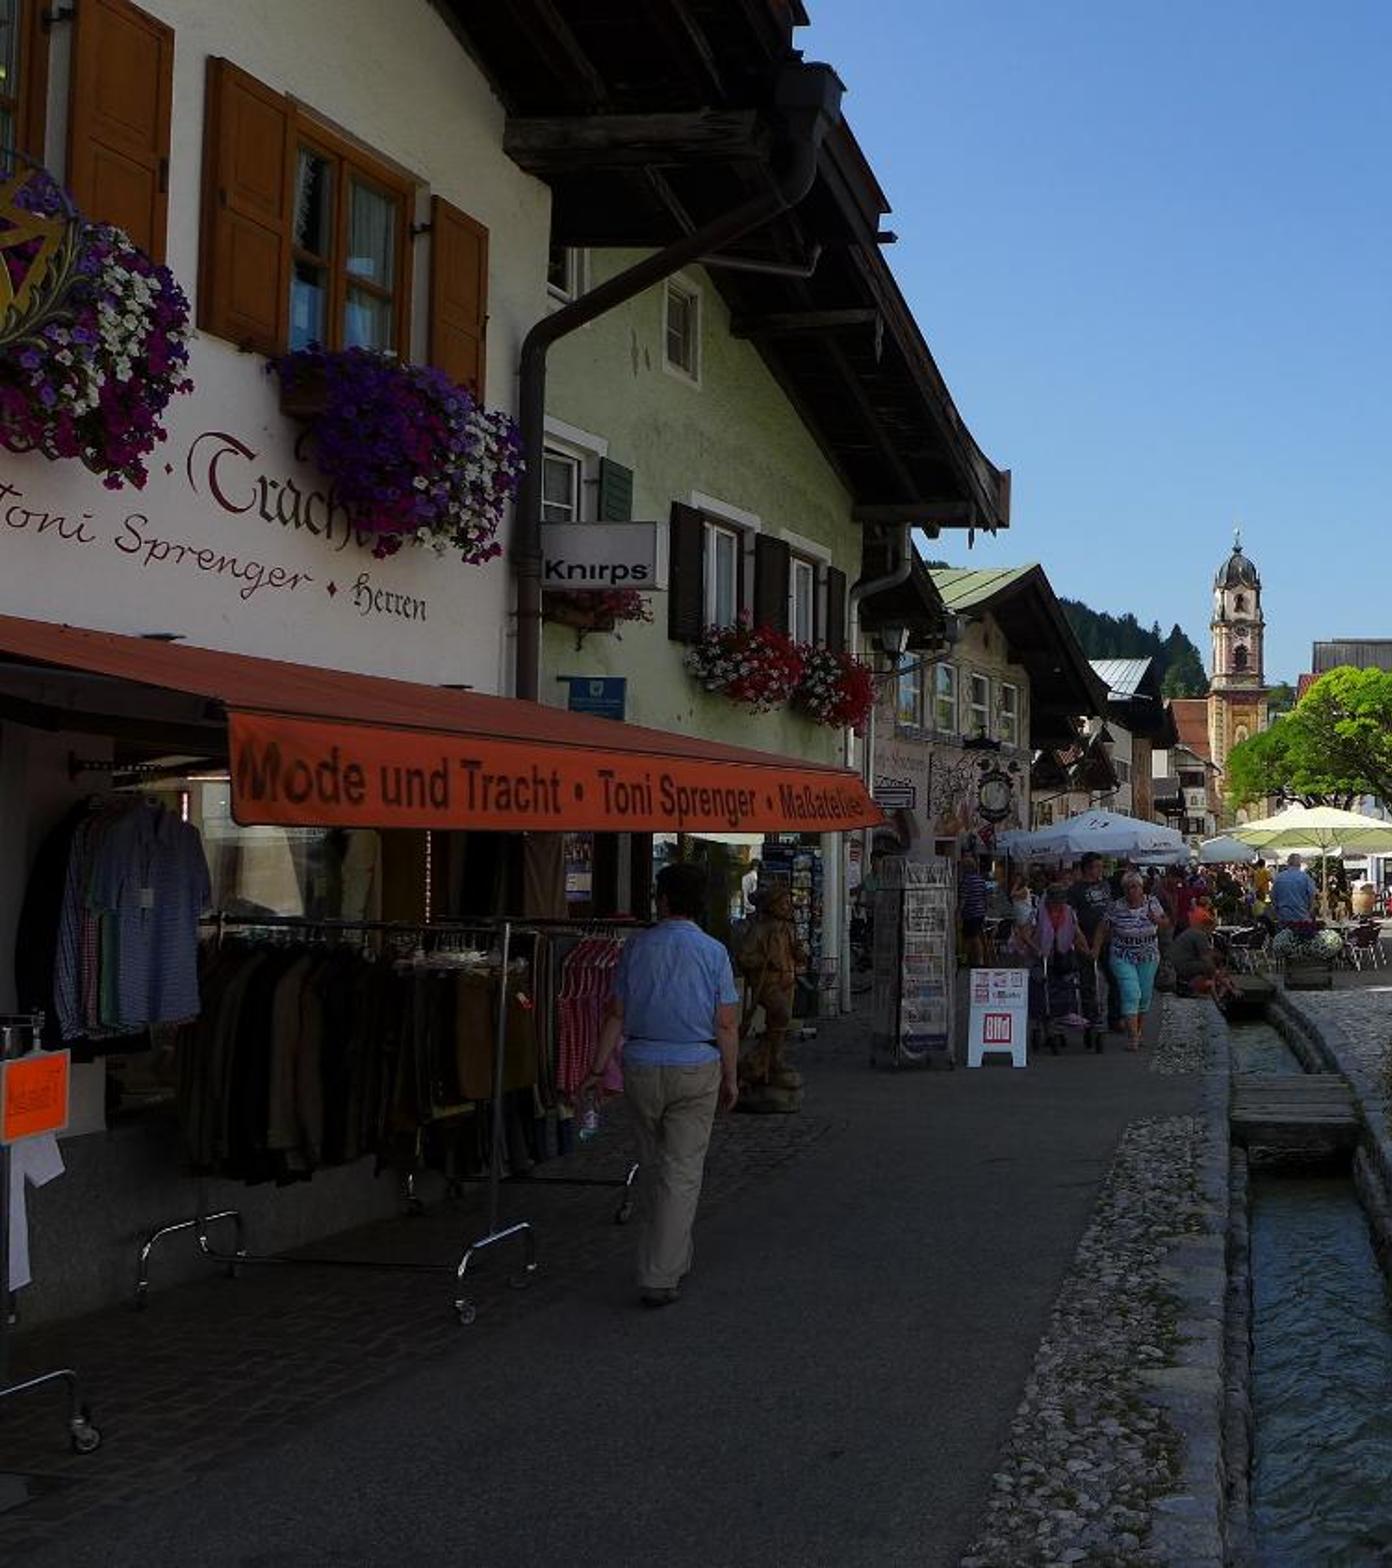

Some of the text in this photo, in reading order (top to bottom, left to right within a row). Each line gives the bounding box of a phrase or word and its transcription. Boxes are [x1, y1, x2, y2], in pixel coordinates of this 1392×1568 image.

[114, 513, 313, 600] Sprenger
[351, 572, 426, 622] Herren
[544, 559, 648, 585] Knirps
[237, 740, 366, 804] Mode
[380, 757, 449, 809] und
[460, 759, 562, 814] Tracht
[597, 769, 653, 816] Toni
[659, 772, 756, 828] Sprenger
